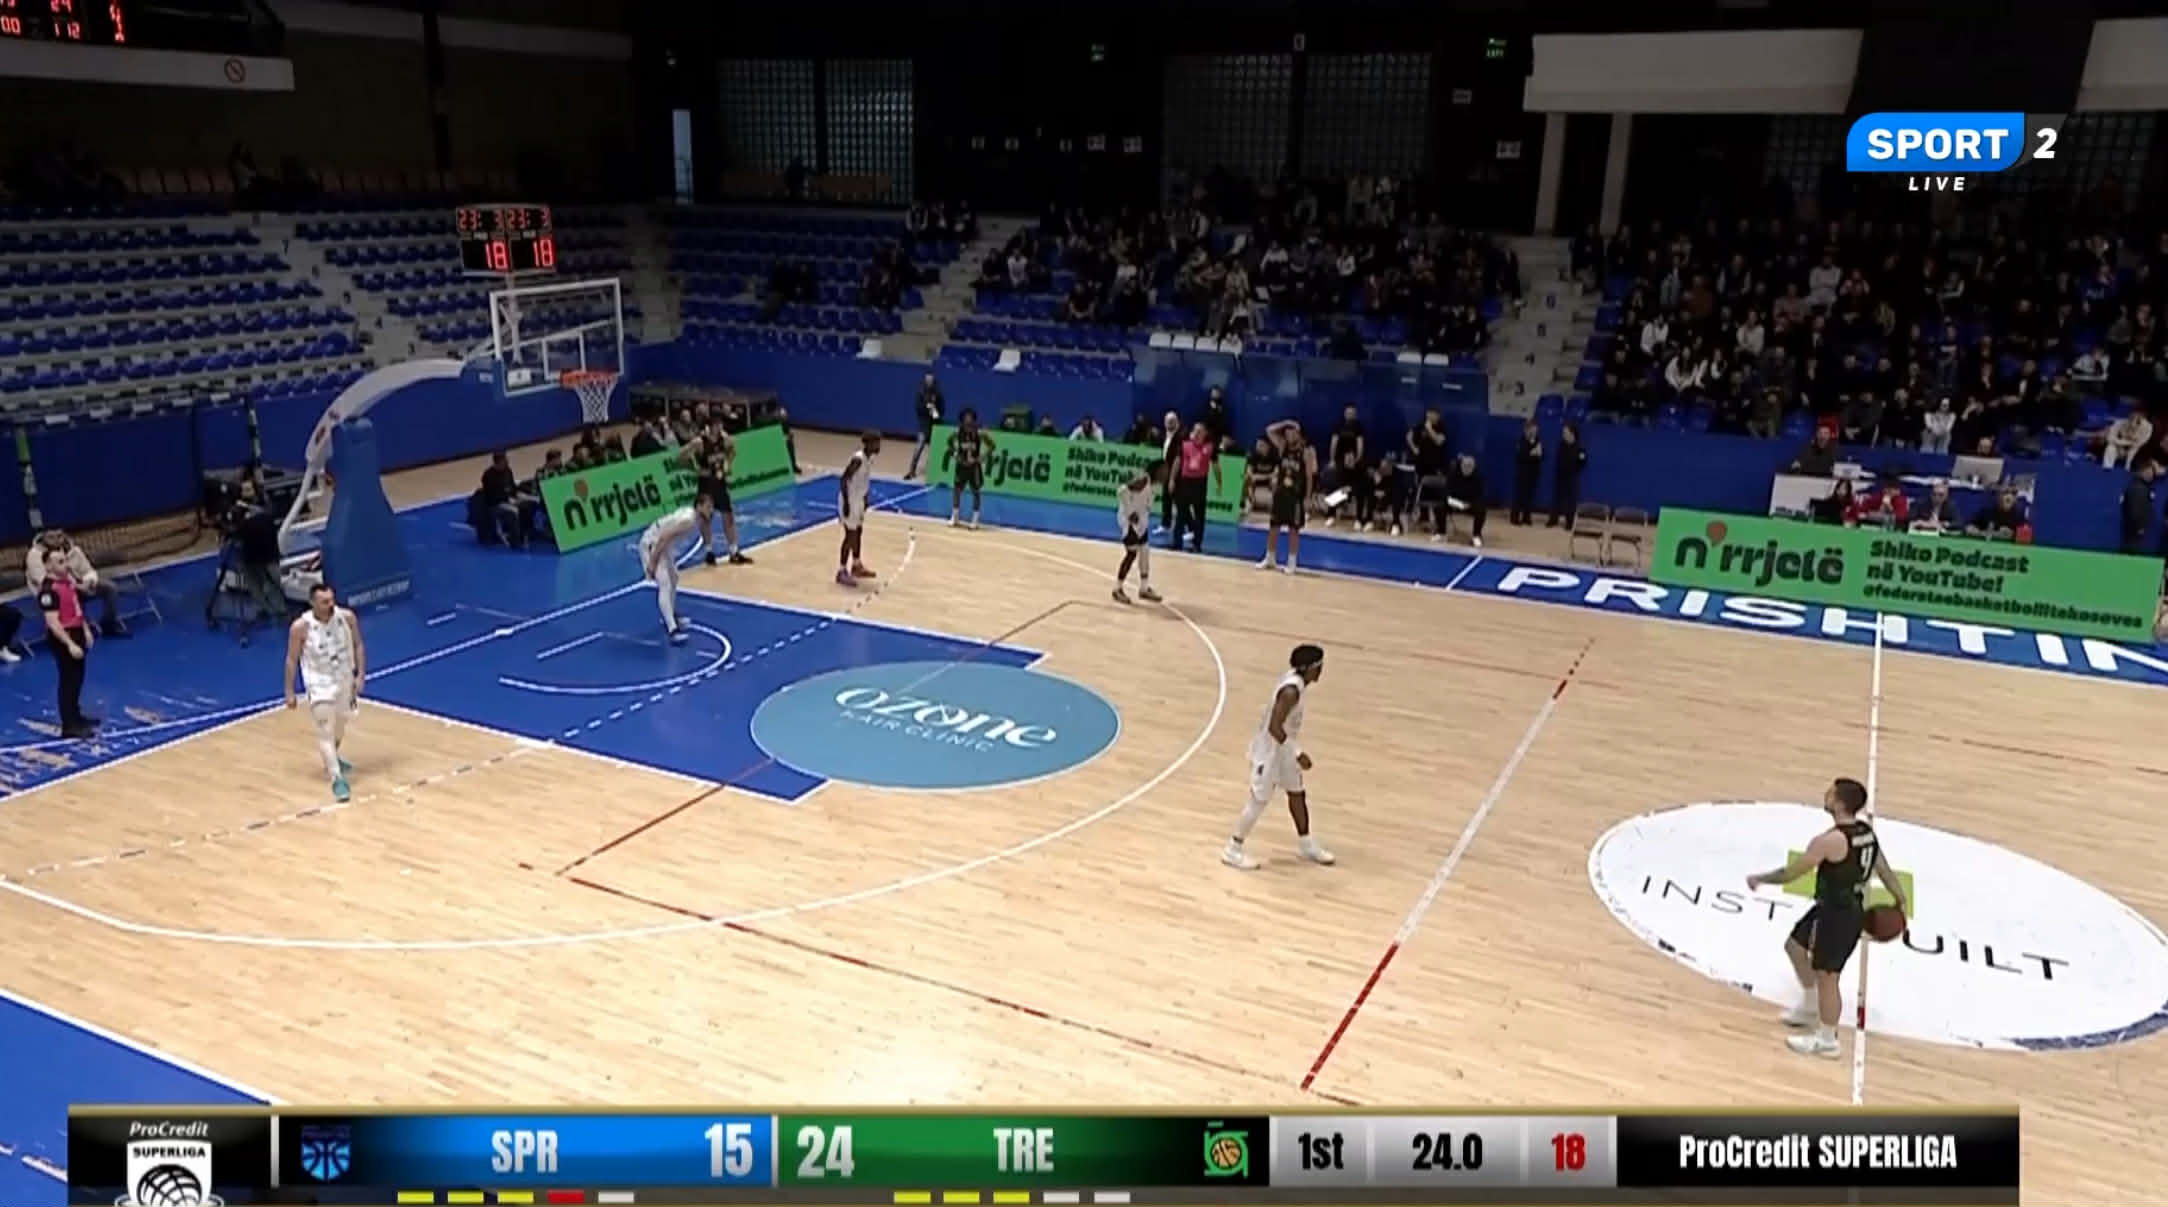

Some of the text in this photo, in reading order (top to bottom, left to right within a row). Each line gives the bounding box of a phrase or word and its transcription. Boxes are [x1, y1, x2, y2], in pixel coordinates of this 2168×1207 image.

[485, 241, 508, 269] 18
[532, 238, 554, 267] 18
[1870, 541, 2030, 574] Shiko Podcast
[1867, 563, 2004, 594] në YouTube!
[904, 726, 995, 752] CLINIC
